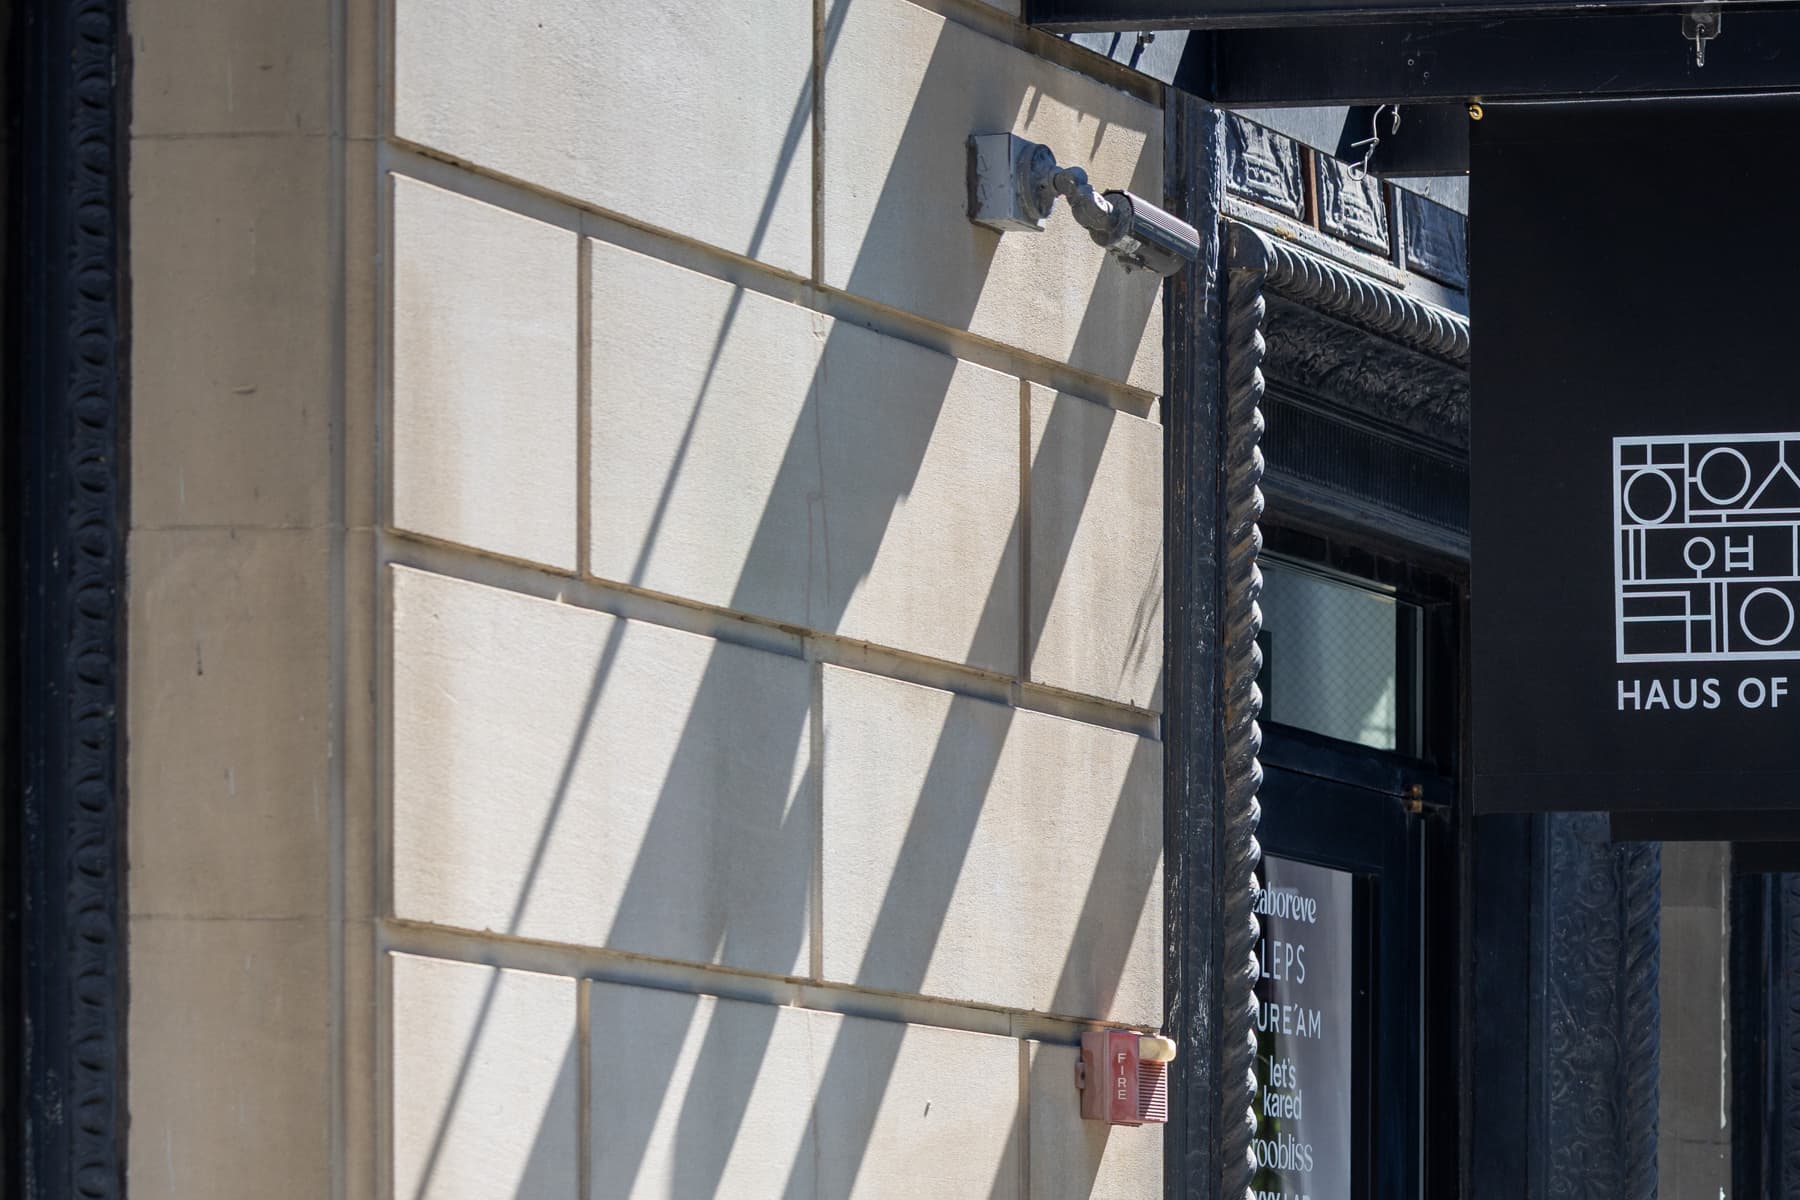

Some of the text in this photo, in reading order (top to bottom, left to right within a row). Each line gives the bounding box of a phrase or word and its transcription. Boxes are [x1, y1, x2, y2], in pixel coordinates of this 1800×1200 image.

[1617, 677, 1721, 711] HAUS
[1737, 676, 1789, 710] OF
[1260, 938, 1306, 985] LEPS
[1117, 1052, 1128, 1101] FIRE
[1269, 1055, 1297, 1090] let's
[1263, 1085, 1303, 1121] kared
